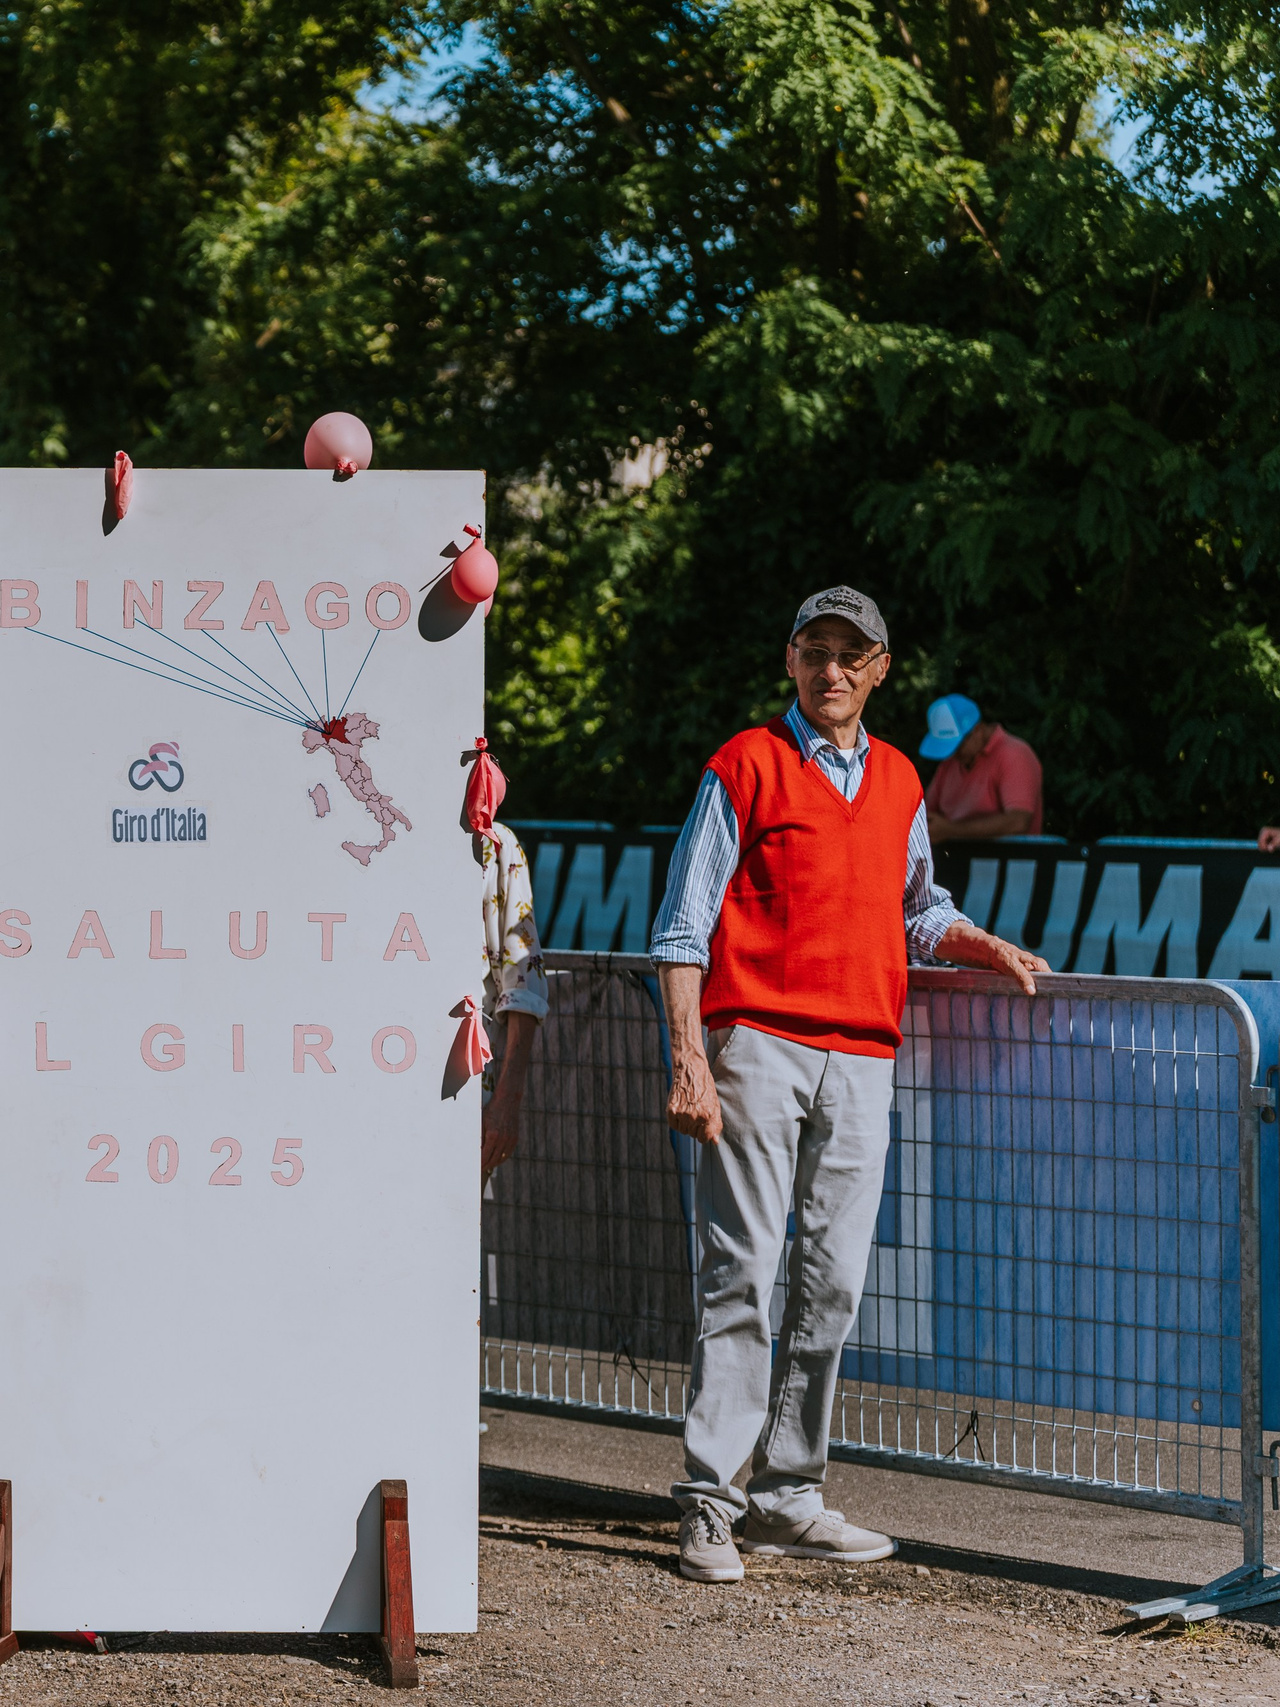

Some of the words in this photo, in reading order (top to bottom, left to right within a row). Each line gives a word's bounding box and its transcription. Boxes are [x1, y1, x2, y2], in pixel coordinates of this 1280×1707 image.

[0, 579, 411, 633] BINZAGO
[112, 808, 147, 843] Giro
[151, 807, 207, 842] d'Italia
[140, 1022, 417, 1074] GIRO
[85, 1133, 305, 1187] 2025
